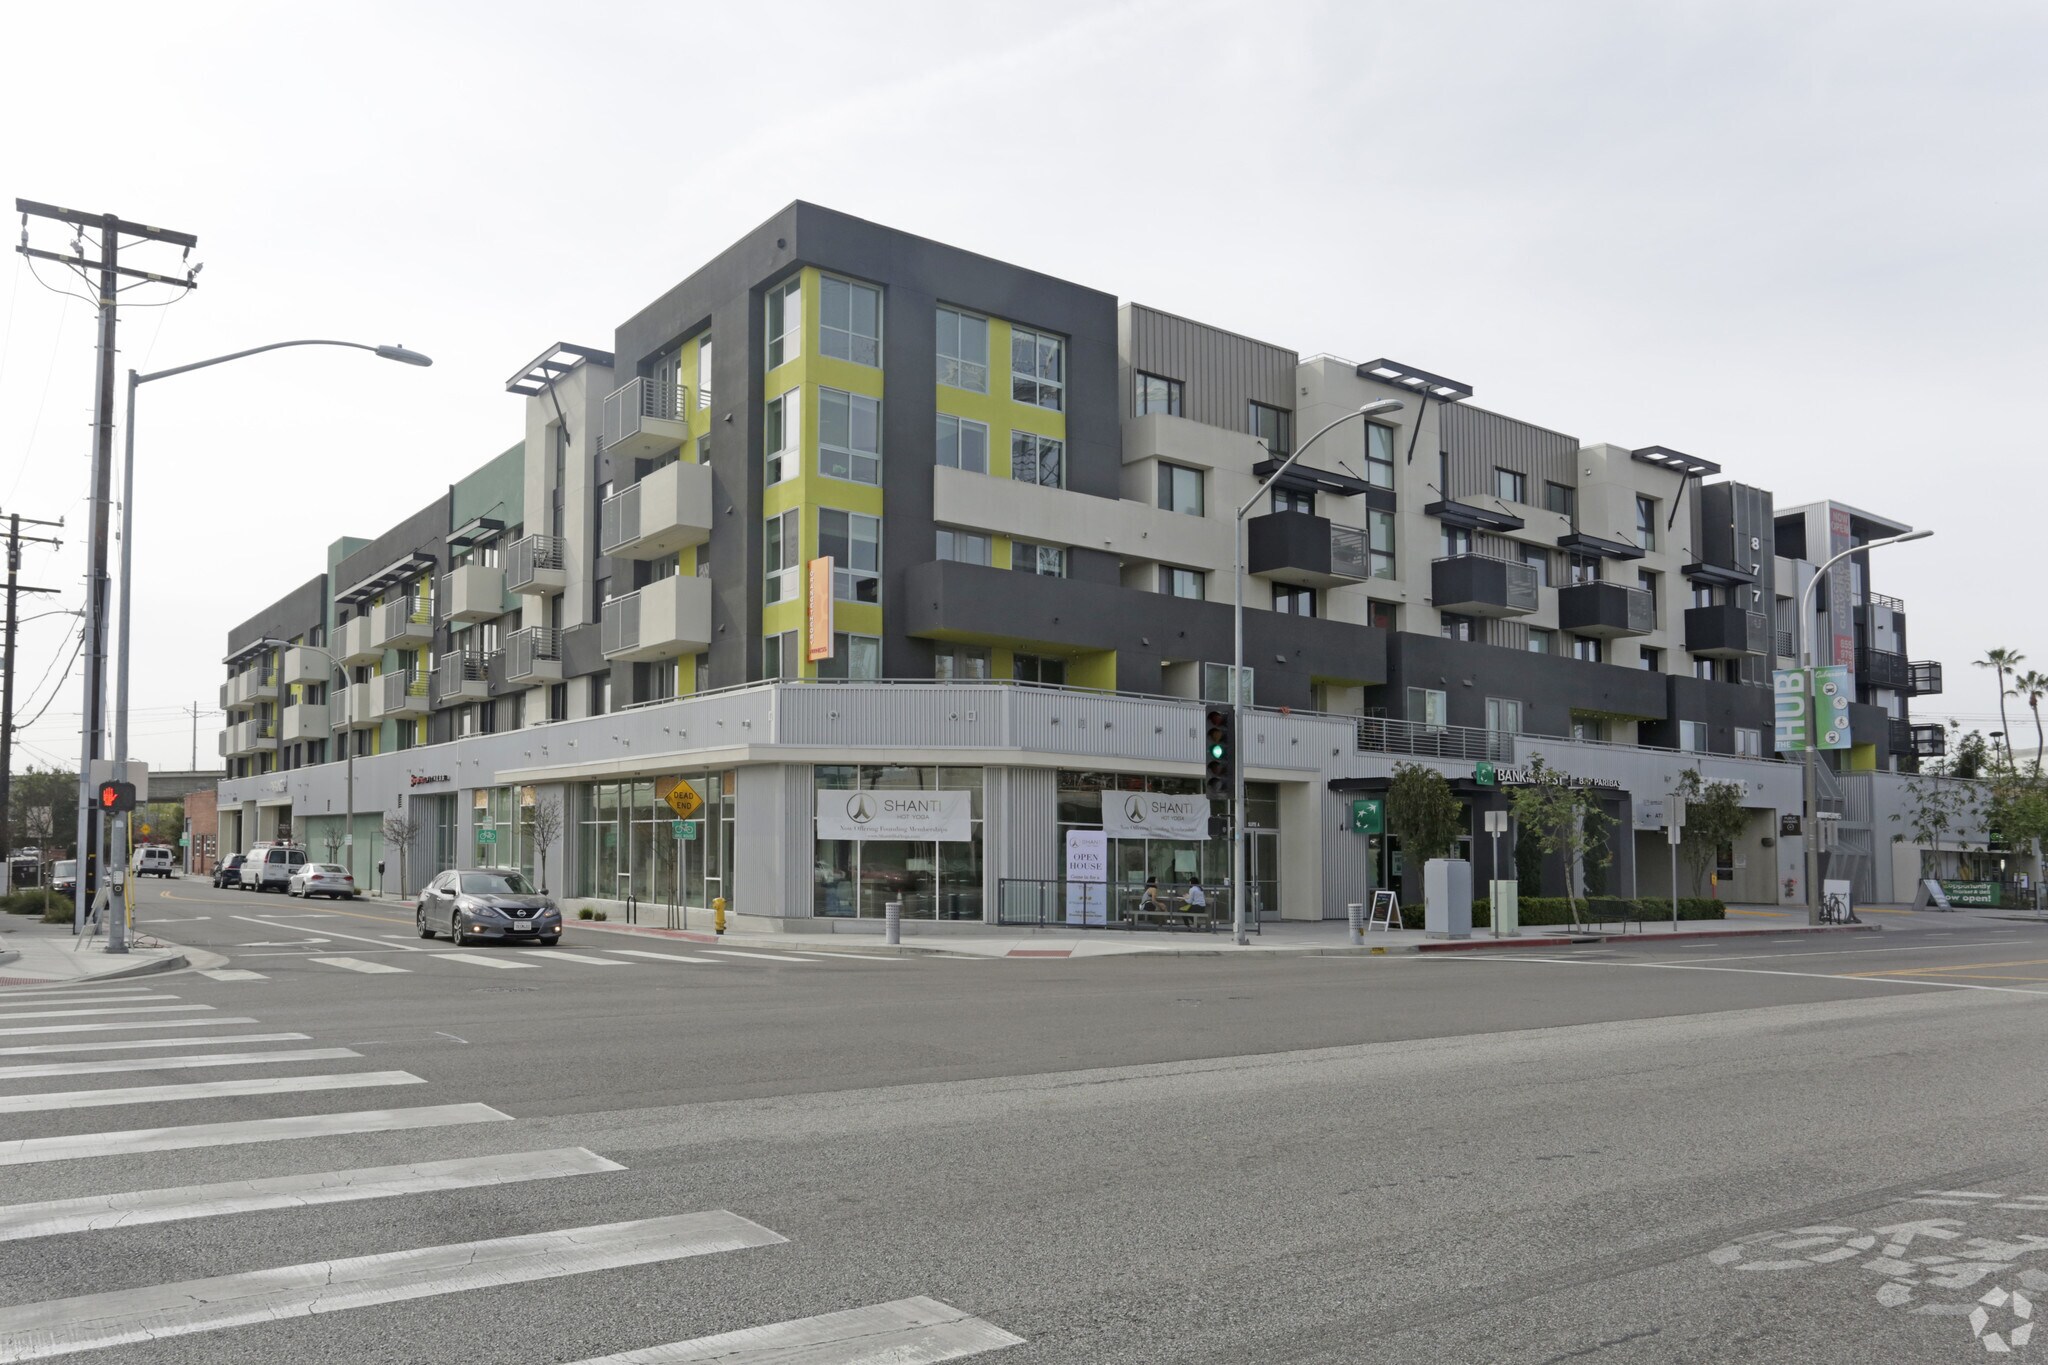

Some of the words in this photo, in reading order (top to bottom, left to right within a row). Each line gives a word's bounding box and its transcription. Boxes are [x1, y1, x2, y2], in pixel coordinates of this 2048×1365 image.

[1833, 512, 1848, 524] NOW
[1831, 522, 1848, 533] OPEN
[1775, 672, 1805, 740] HUB
[1497, 768, 1526, 783] BANK
[1594, 778, 1621, 788] PARIBAS
[674, 791, 693, 800] DEAD
[677, 802, 691, 810] END
[884, 799, 942, 812] SHANTI
[1151, 801, 1193, 814] SHANTI
[854, 825, 878, 833] Offering
[909, 826, 948, 834] Memberships
[1073, 853, 1098, 861] OPEN
[1070, 862, 1102, 870] HOUSE
[1962, 895, 1991, 903] open!
